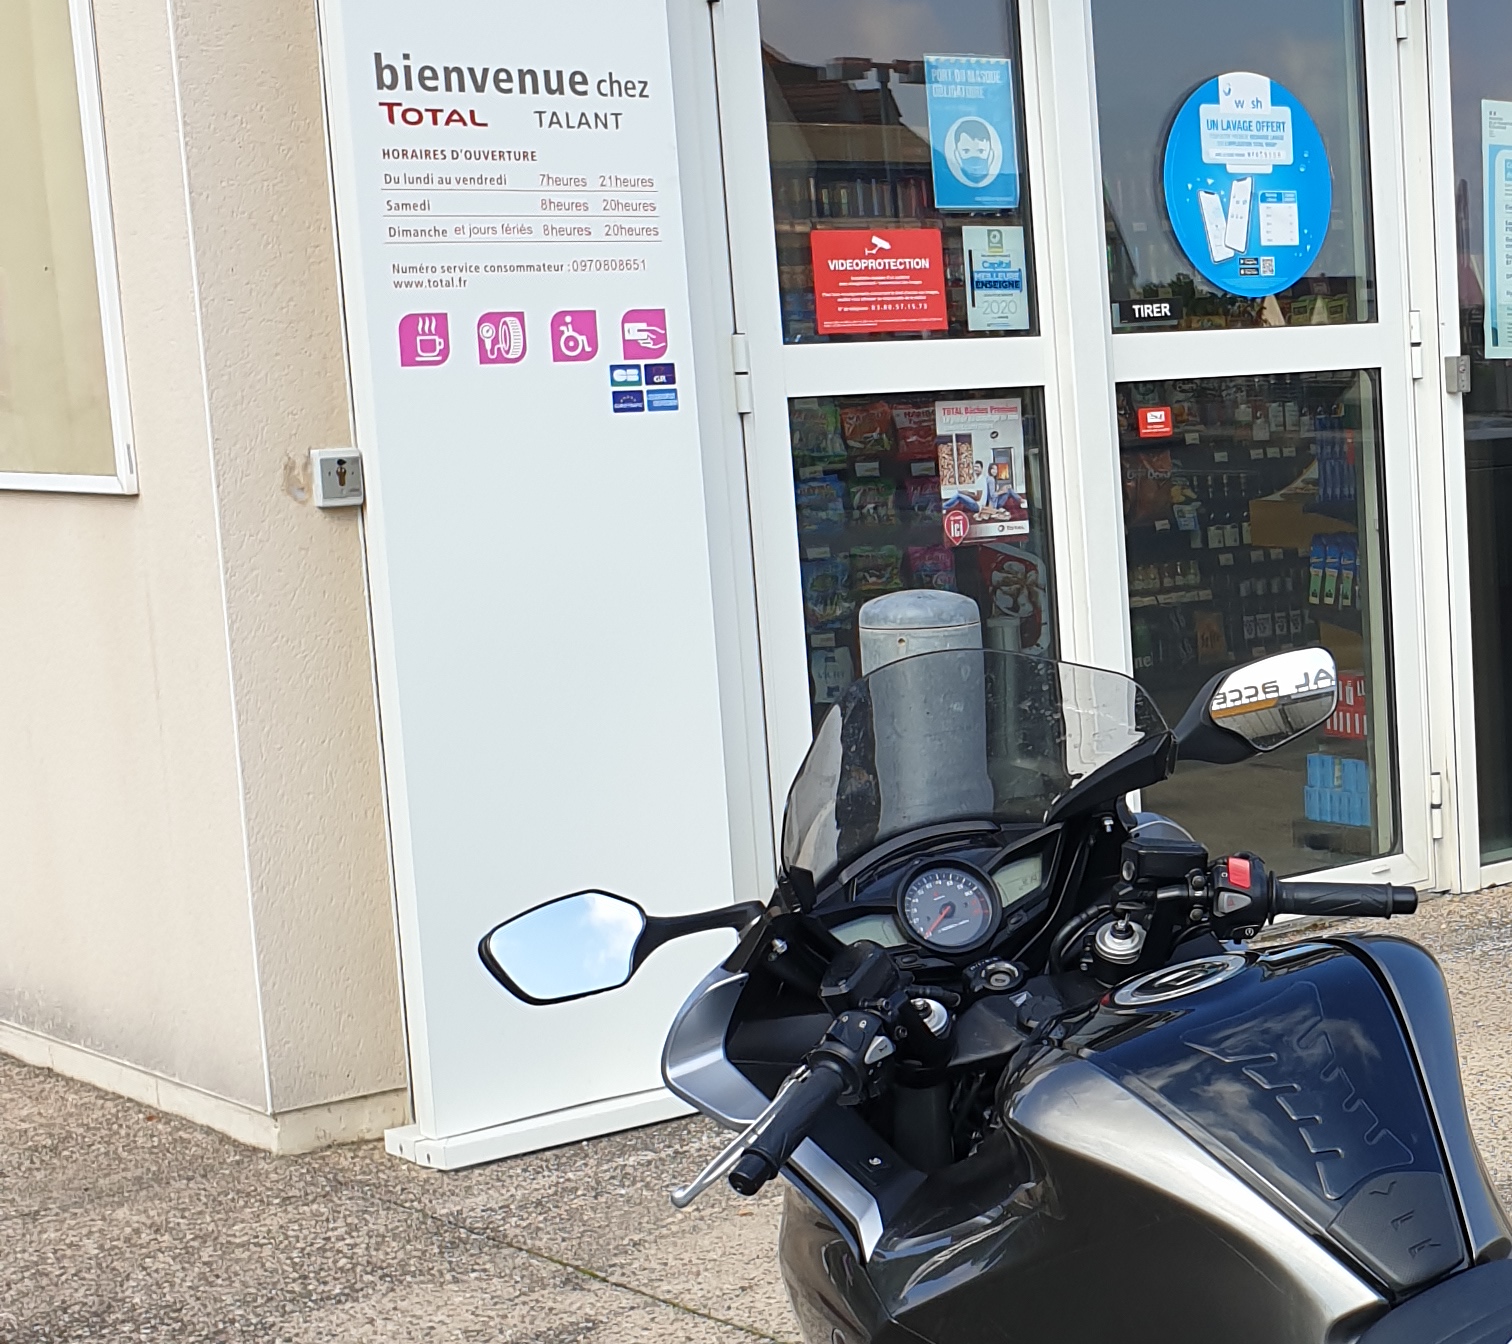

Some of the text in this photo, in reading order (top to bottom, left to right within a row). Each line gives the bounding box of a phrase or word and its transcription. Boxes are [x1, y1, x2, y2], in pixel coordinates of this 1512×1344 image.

[374, 52, 650, 98] bienvenue chez
[378, 102, 623, 130] TOTAL TALANT
[1206, 119, 1286, 133] UN LAVAGE OFFERT
[382, 148, 537, 162] HORAIRES D'OUVERTURE
[384, 173, 654, 188] Du lundi au vendredi 7heures 21heures
[386, 198, 657, 212] Samedi 8heures 20heures
[388, 223, 659, 238] Dimanche et jours fériés 8heures 20heures
[392, 262, 437, 274] Numéro
[440, 262, 480, 274] service
[483, 262, 564, 274] consommateur
[828, 258, 930, 271] VIDEOPROTECTION
[393, 276, 468, 289] www.total.fr
[982, 299, 1018, 315] 2020
[1132, 303, 1171, 318] TIRER
[950, 520, 963, 537] ici
